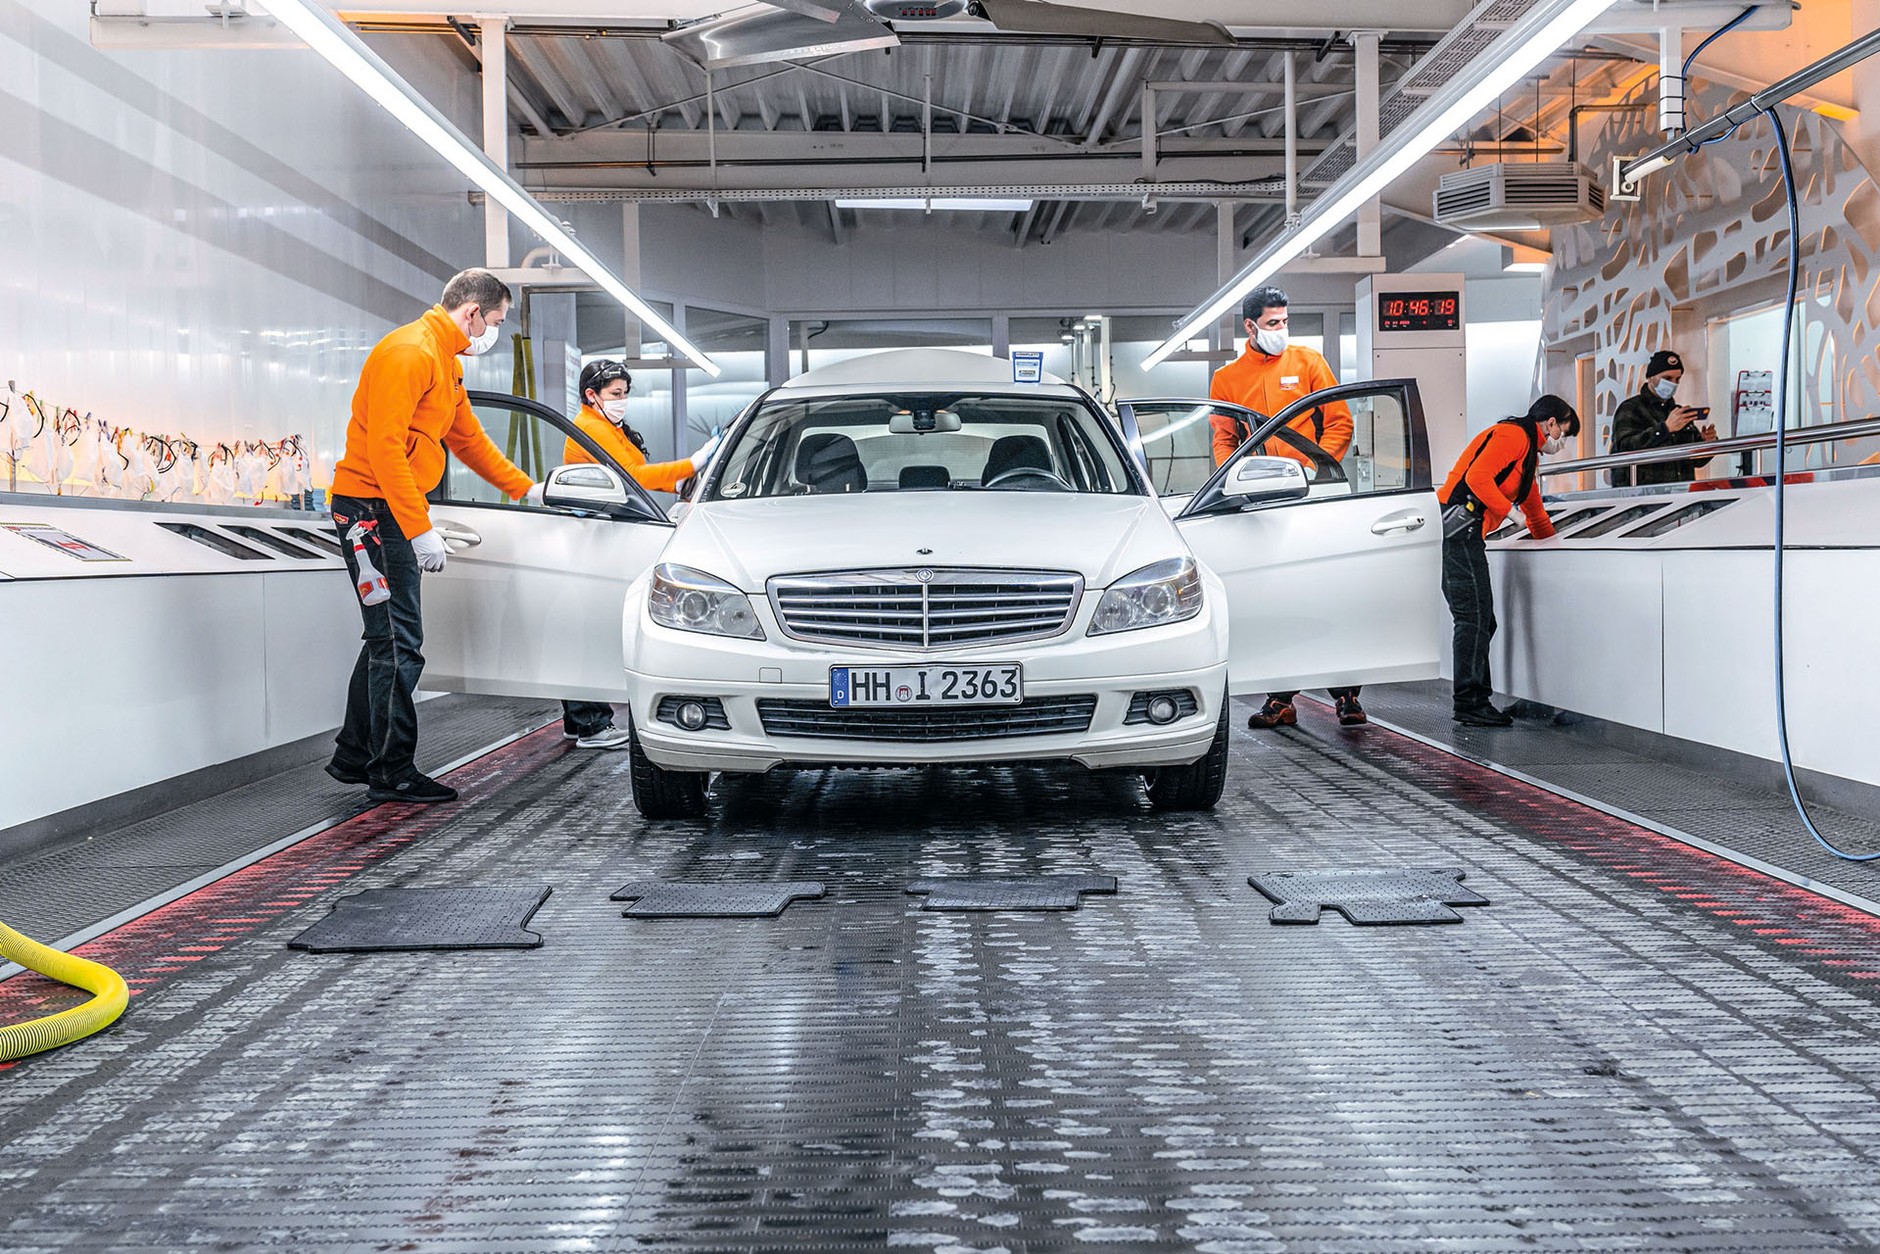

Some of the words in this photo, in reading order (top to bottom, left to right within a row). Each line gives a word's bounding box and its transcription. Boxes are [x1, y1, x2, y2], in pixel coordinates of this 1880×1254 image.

[1389, 299, 1455, 316] 10:46:19
[851, 672, 891, 701] HH
[915, 671, 931, 700] I
[941, 670, 1017, 699] 2363
[837, 691, 844, 699] D
